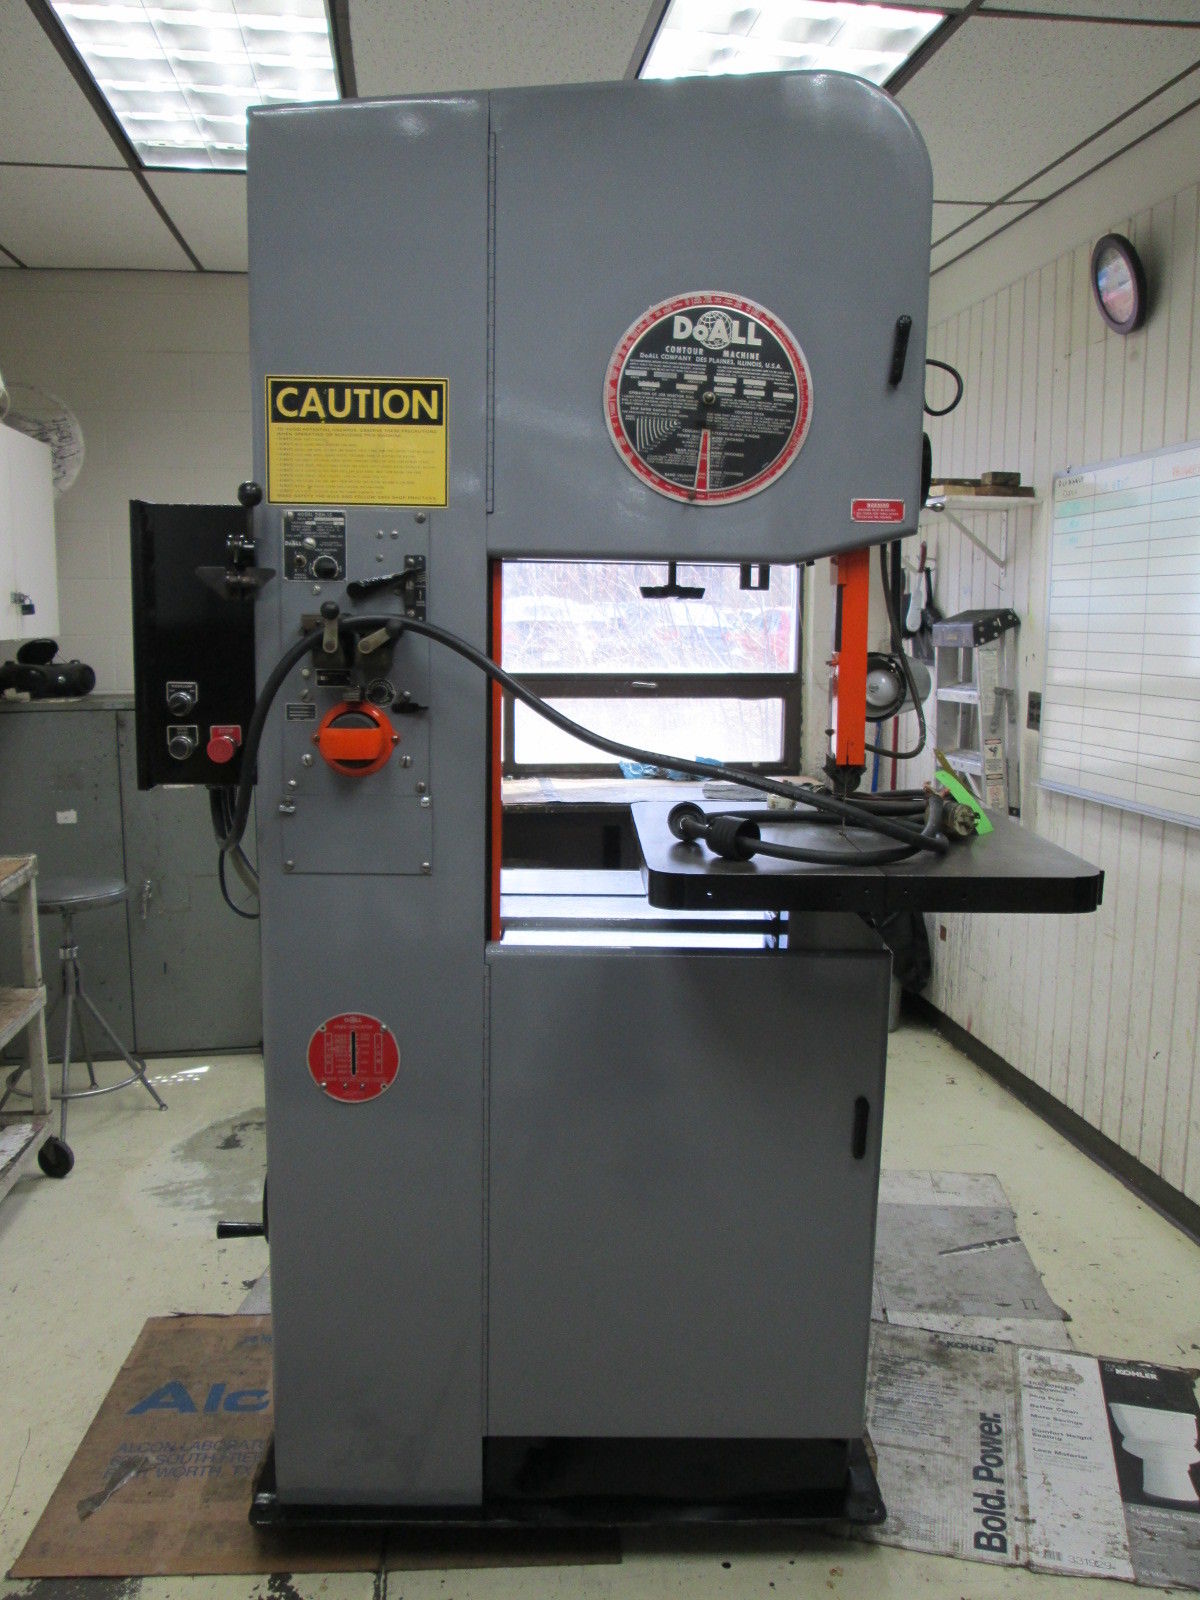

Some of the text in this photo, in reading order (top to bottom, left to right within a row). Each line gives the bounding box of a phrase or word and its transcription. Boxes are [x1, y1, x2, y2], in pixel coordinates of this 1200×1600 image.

[673, 315, 762, 346] DoALL
[660, 354, 692, 362] COMPANY
[665, 345, 760, 360] CONTOUR MACHINE
[276, 387, 438, 420] CAUTION
[1115, 1368, 1159, 1380] KOHLER
[972, 1412, 1008, 1554] Bold. Power.
